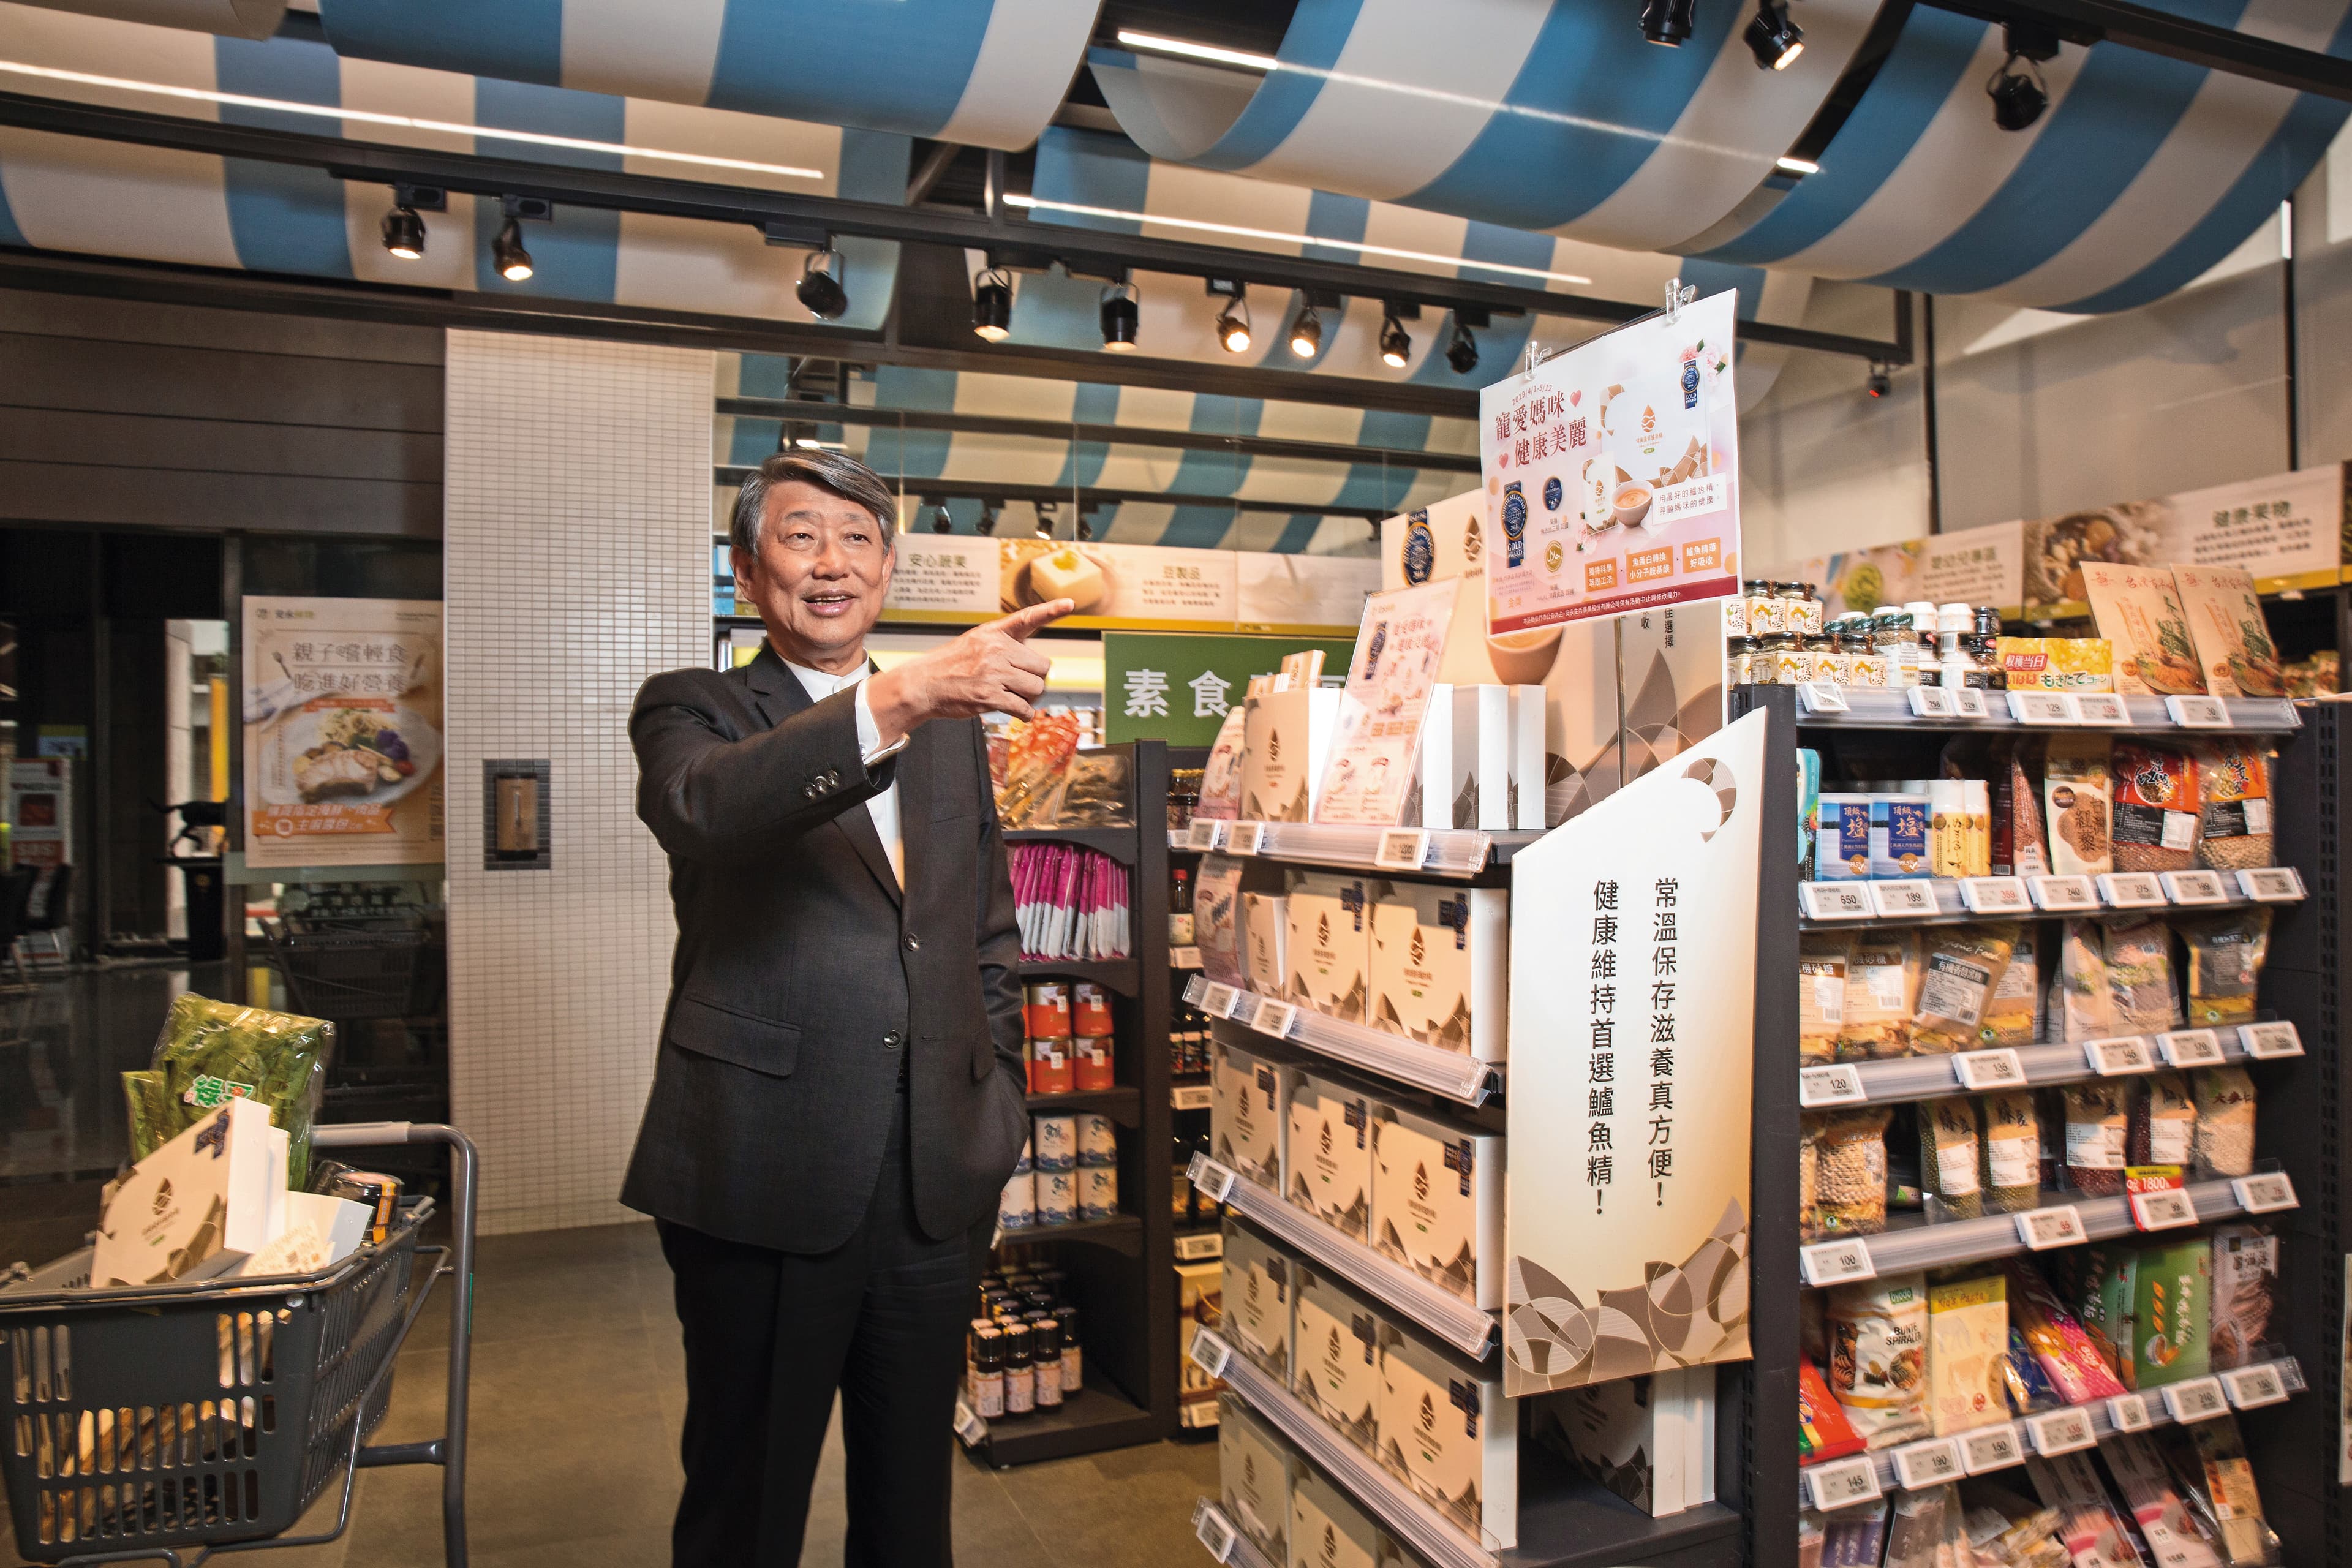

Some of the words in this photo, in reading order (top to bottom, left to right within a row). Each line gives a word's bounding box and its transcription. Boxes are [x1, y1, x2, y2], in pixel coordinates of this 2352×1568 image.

[1512, 383, 1553, 405] 2019/4/1-5/12
[1495, 391, 1565, 442] 寵愛媽咪
[1514, 417, 1587, 468] 健康美麗
[1507, 541, 1523, 551] GOLD
[1686, 542, 1717, 558] 鱸魚精華
[1507, 549, 1523, 558] AWARD
[1632, 553, 1667, 568] 魚蛋白轉換
[1690, 556, 1714, 569] 好吸收
[1588, 562, 1613, 577] 獨特科學
[1629, 564, 1670, 580] 小分子胺基酸
[1589, 575, 1613, 588] 萃取工法
[2005, 654, 2045, 668] 収穫当日
[2041, 672, 2087, 687] もぎたて
[2046, 704, 2060, 712] 129
[1893, 806, 1912, 816] 頂級
[1896, 816, 1919, 837] 塩
[1905, 892, 1921, 902] 189
[2066, 887, 2081, 896] 240
[1840, 895, 1856, 905] 650
[1975, 945, 2001, 962] Food
[1799, 962, 1834, 976] 機砂糖
[1586, 878, 1620, 1216] 健康維持首選鱸魚精！
[1647, 877, 1679, 1208] 常溫保存滋養真方便！
[1992, 1063, 2008, 1073] 135
[1830, 1079, 1847, 1089] 120
[2141, 1176, 2166, 1190] 1800
[1839, 1254, 1856, 1266] 100
[1890, 1290, 1912, 1302] byodo
[1961, 1292, 1985, 1304] Pasta
[1894, 1322, 1918, 1336] BUNTE
[1992, 1441, 2007, 1452] 150
[1932, 1454, 1947, 1466] 190
[1847, 1475, 1863, 1487] 145
